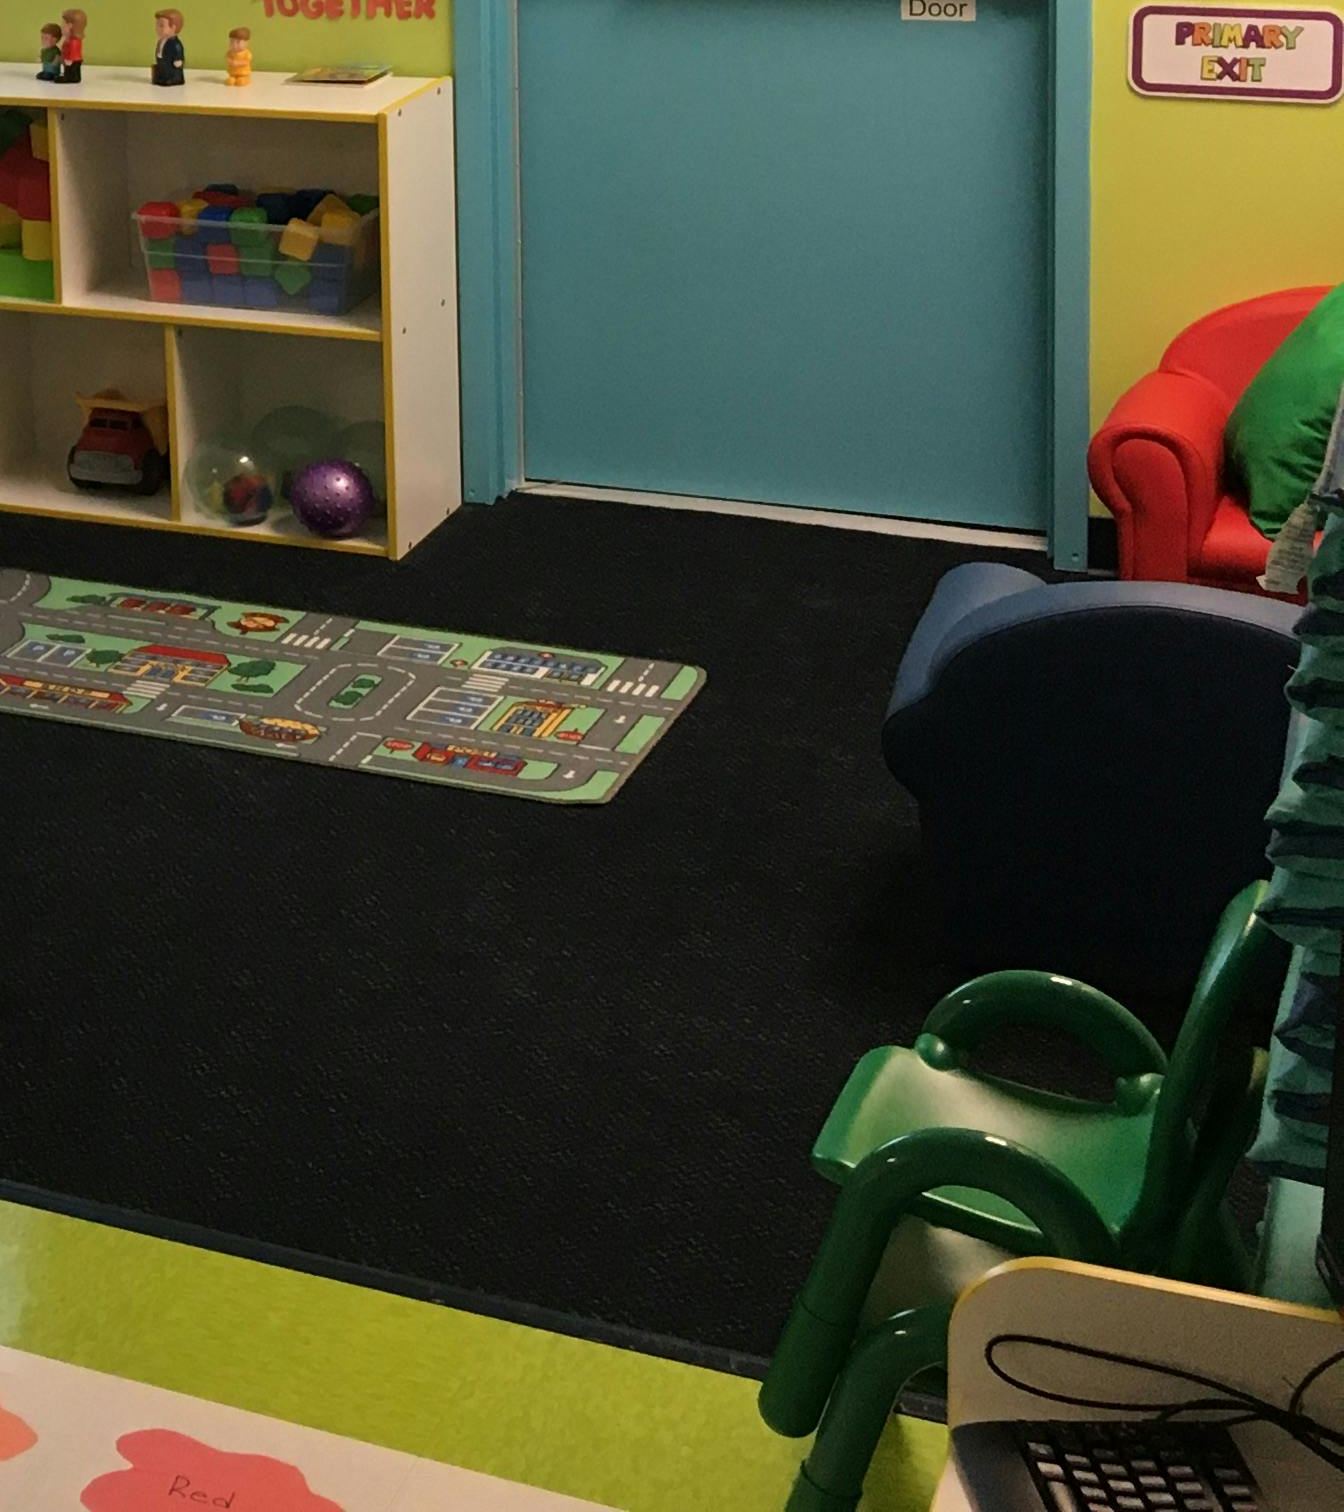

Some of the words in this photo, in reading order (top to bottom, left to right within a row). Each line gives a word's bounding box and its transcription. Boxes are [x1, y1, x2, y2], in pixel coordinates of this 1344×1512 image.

[1175, 21, 1304, 50] PRIMARY
[1200, 56, 1266, 83] EXIT
[168, 1474, 236, 1510] Red
